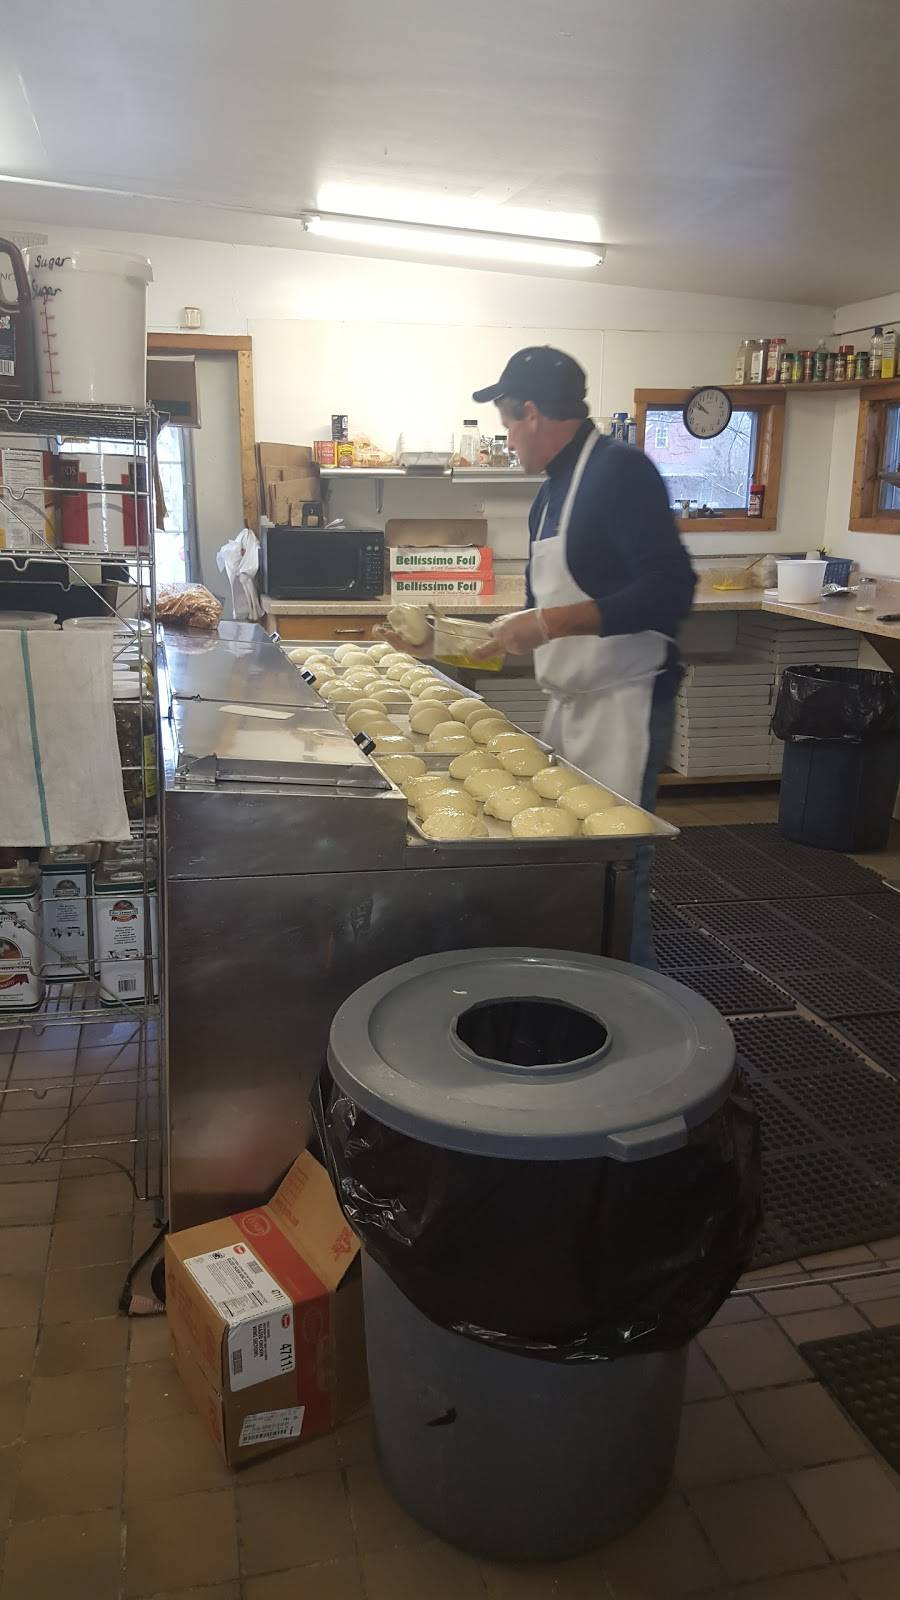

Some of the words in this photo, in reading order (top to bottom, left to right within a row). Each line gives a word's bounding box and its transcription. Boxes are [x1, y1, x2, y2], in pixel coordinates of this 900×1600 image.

[34, 255, 71, 270] Sugar
[396, 555, 453, 566] Bellissimo
[456, 555, 476, 565] Foil
[396, 581, 454, 591] Bellissimo
[457, 581, 477, 591] Foil
